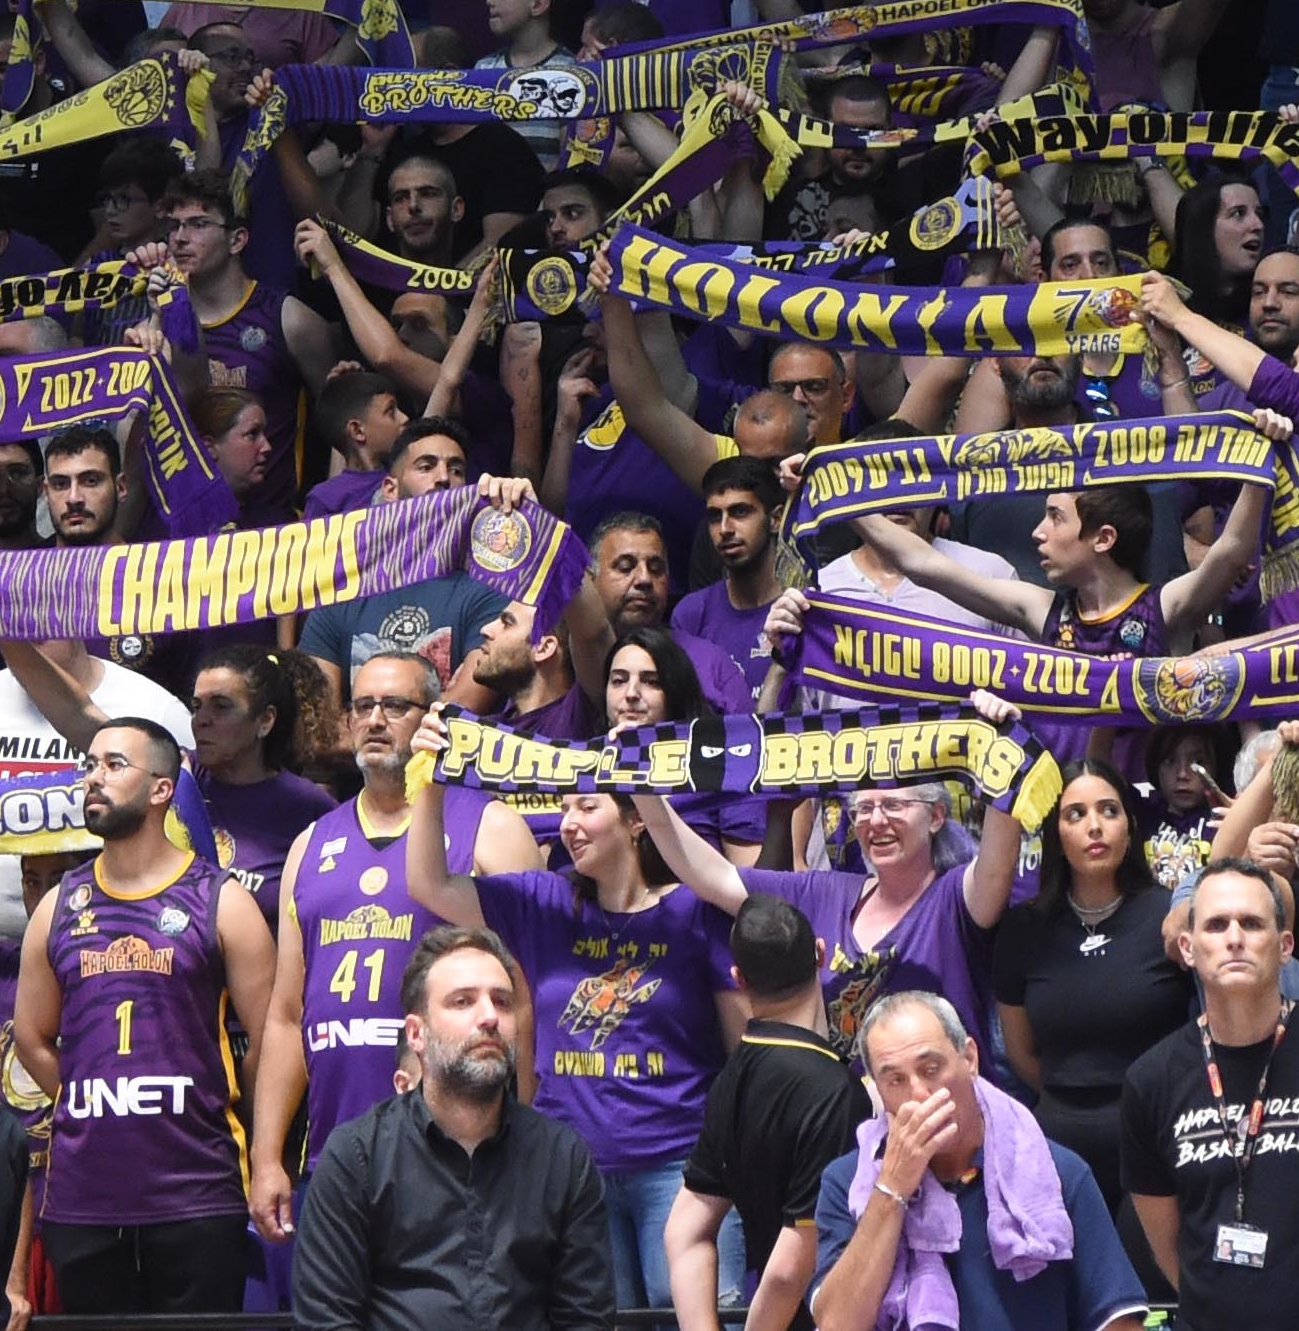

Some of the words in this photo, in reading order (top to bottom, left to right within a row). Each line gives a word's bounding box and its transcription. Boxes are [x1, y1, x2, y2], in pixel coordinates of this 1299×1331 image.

[361, 83, 538, 120] BROTHERS
[979, 113, 1101, 166] Way
[407, 267, 474, 291] 2008
[619, 235, 1009, 358] HOLONIA
[1065, 332, 1121, 354] YEARS
[40, 371, 99, 407] 2022
[1093, 428, 1167, 466] 2008
[1171, 421, 1275, 469] המדינה
[807, 469, 862, 503] 2009
[98, 508, 369, 637] CHAMPIONS
[832, 623, 922, 680] אלופה
[931, 641, 1007, 690] 2008
[1022, 655, 1091, 697] 2022
[763, 718, 1023, 800] BROTHERS
[320, 916, 365, 946] HAPOEL
[367, 912, 412, 943] HOLON
[80, 948, 132, 979] HAPOEL
[132, 946, 175, 977] HOLON
[329, 949, 384, 1003] 41
[115, 1001, 134, 1056] 1
[68, 1075, 194, 1120] UNET
